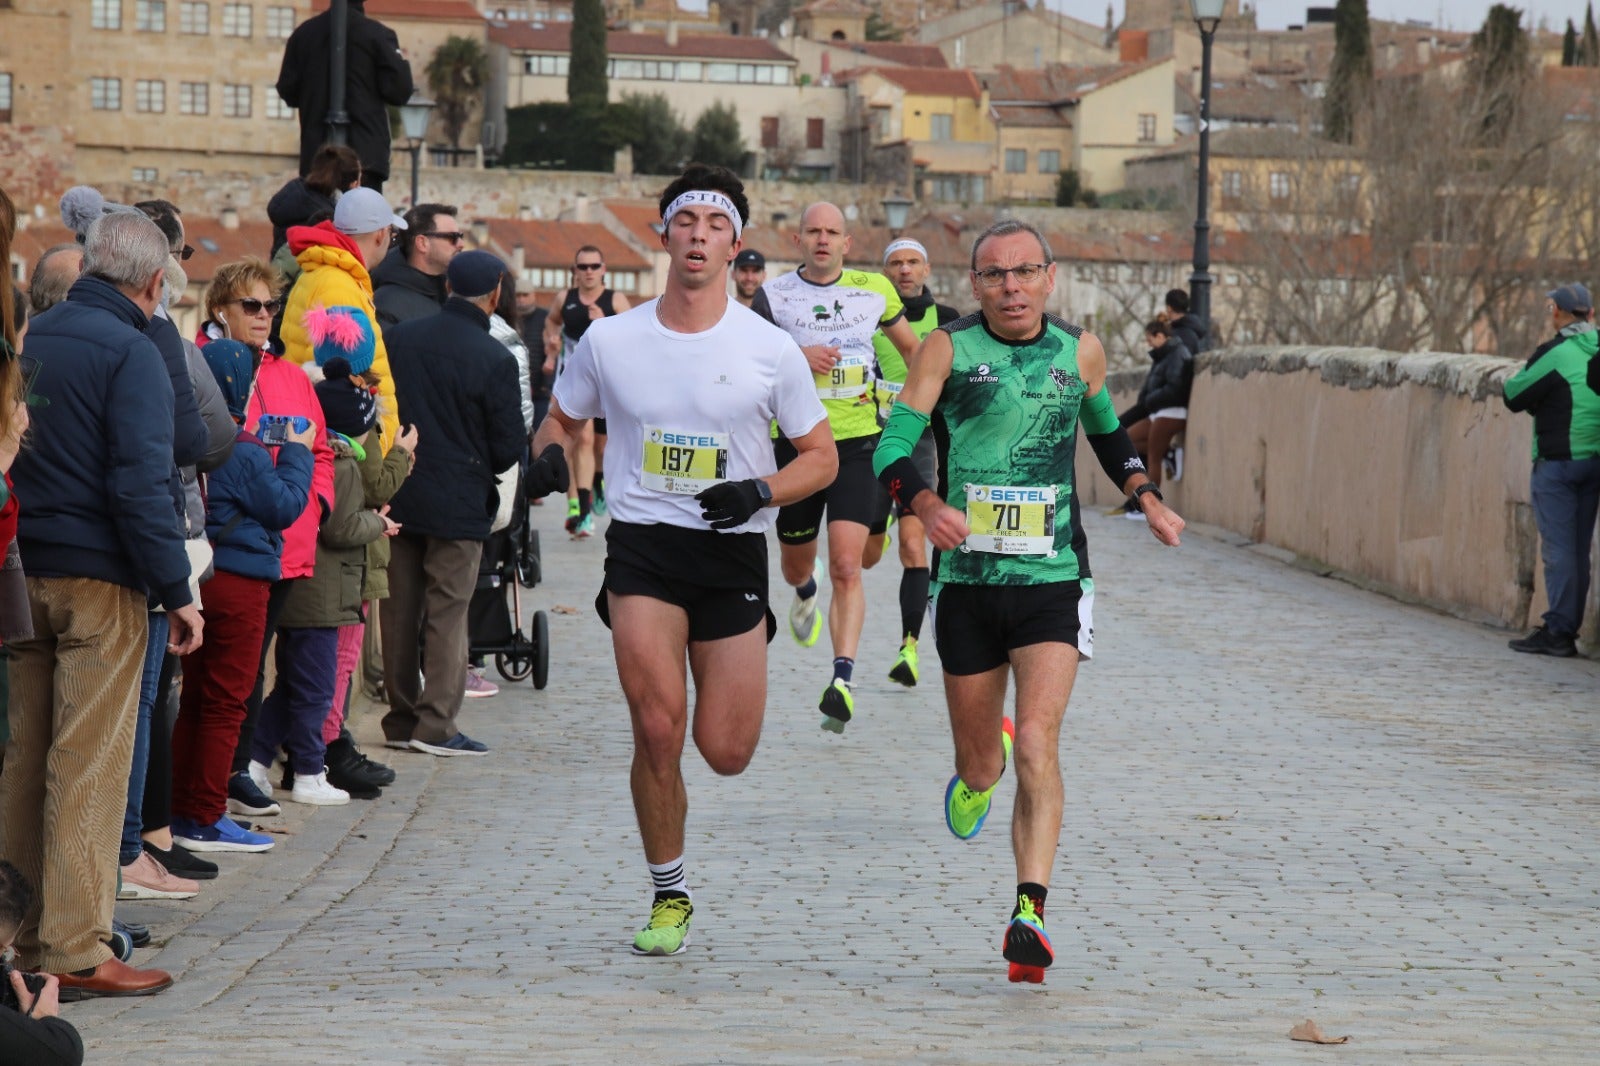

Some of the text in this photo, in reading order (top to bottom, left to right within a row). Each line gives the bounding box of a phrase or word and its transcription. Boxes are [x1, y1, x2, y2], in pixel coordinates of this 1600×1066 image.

[831, 368, 845, 385] 91
[1046, 391, 1056, 400] de
[663, 433, 719, 447] SETEL
[661, 446, 695, 473] 197
[991, 489, 1048, 502] SETEL
[993, 504, 1020, 530] 70
